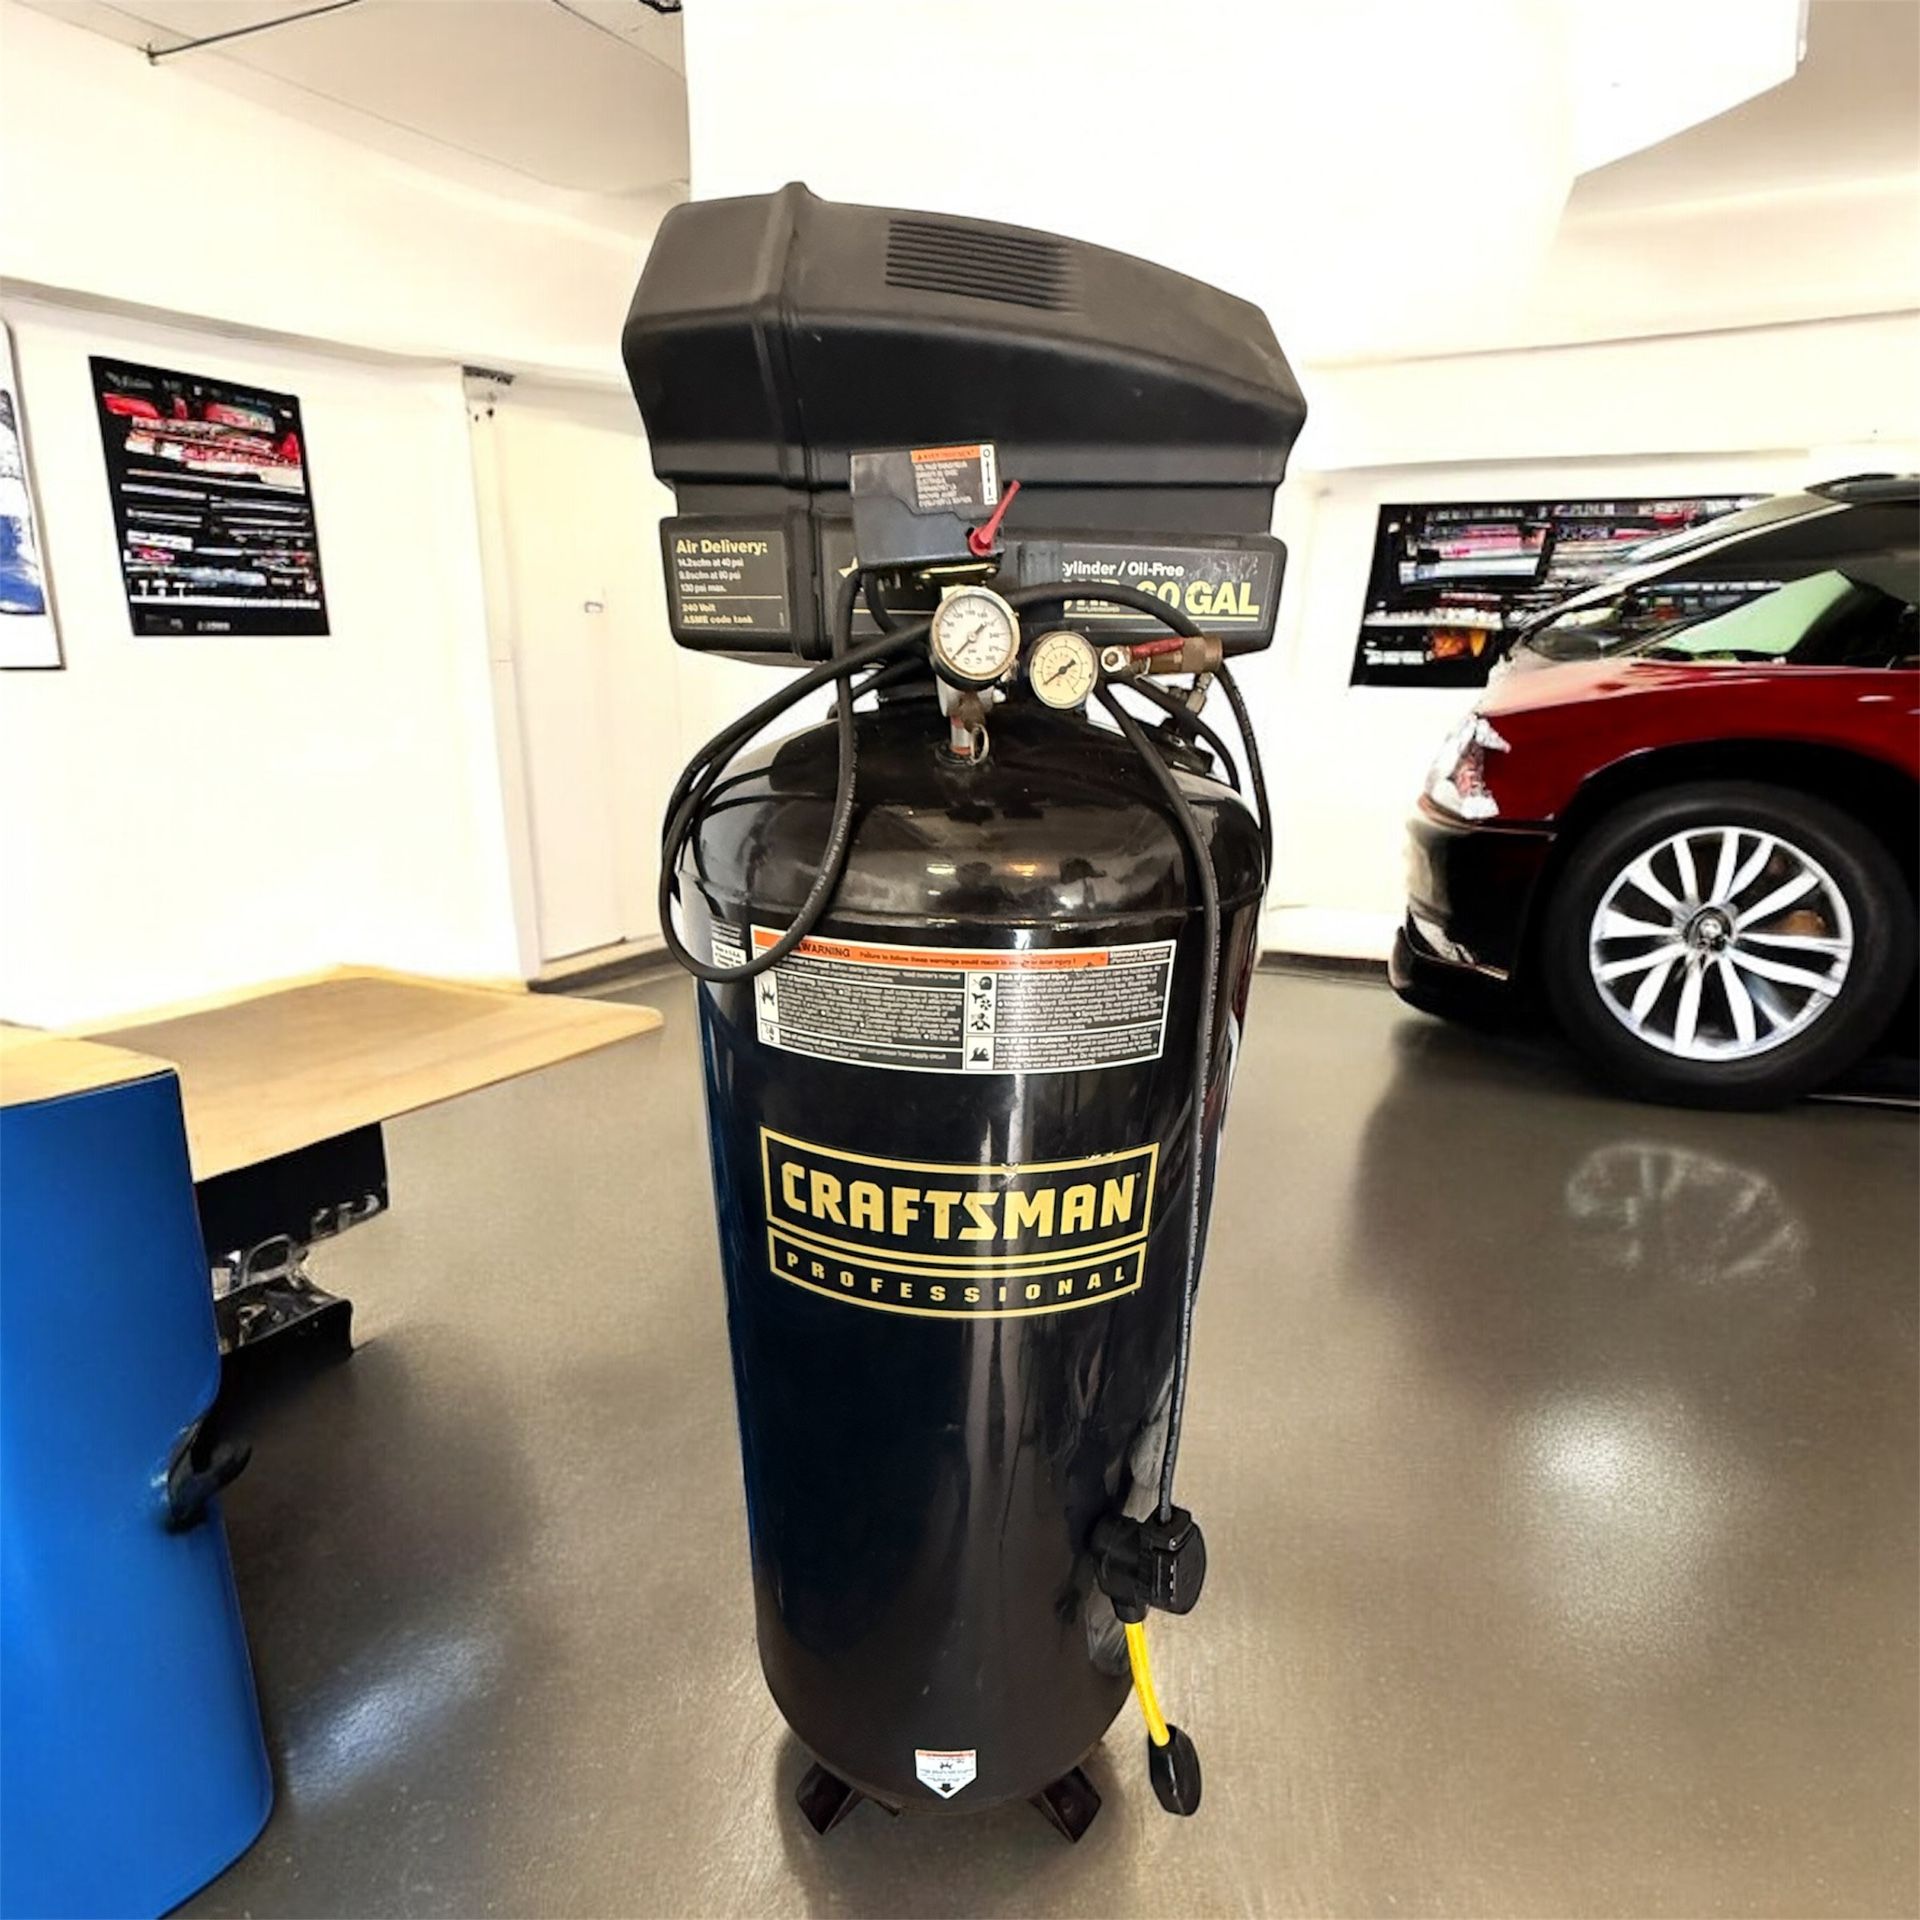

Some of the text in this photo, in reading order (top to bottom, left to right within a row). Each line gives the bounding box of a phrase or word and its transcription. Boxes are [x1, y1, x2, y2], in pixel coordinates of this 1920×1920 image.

[676, 539, 768, 556] Air Delivery:
[1127, 561, 1185, 577] Oil-Free
[1185, 580, 1260, 616] GAL
[709, 615, 732, 624] code
[733, 615, 753, 624] tank
[801, 941, 850, 958] WARNING
[780, 1160, 1137, 1241] CRAFTSMAN
[786, 1250, 1126, 1303] PROFESSIONAL
